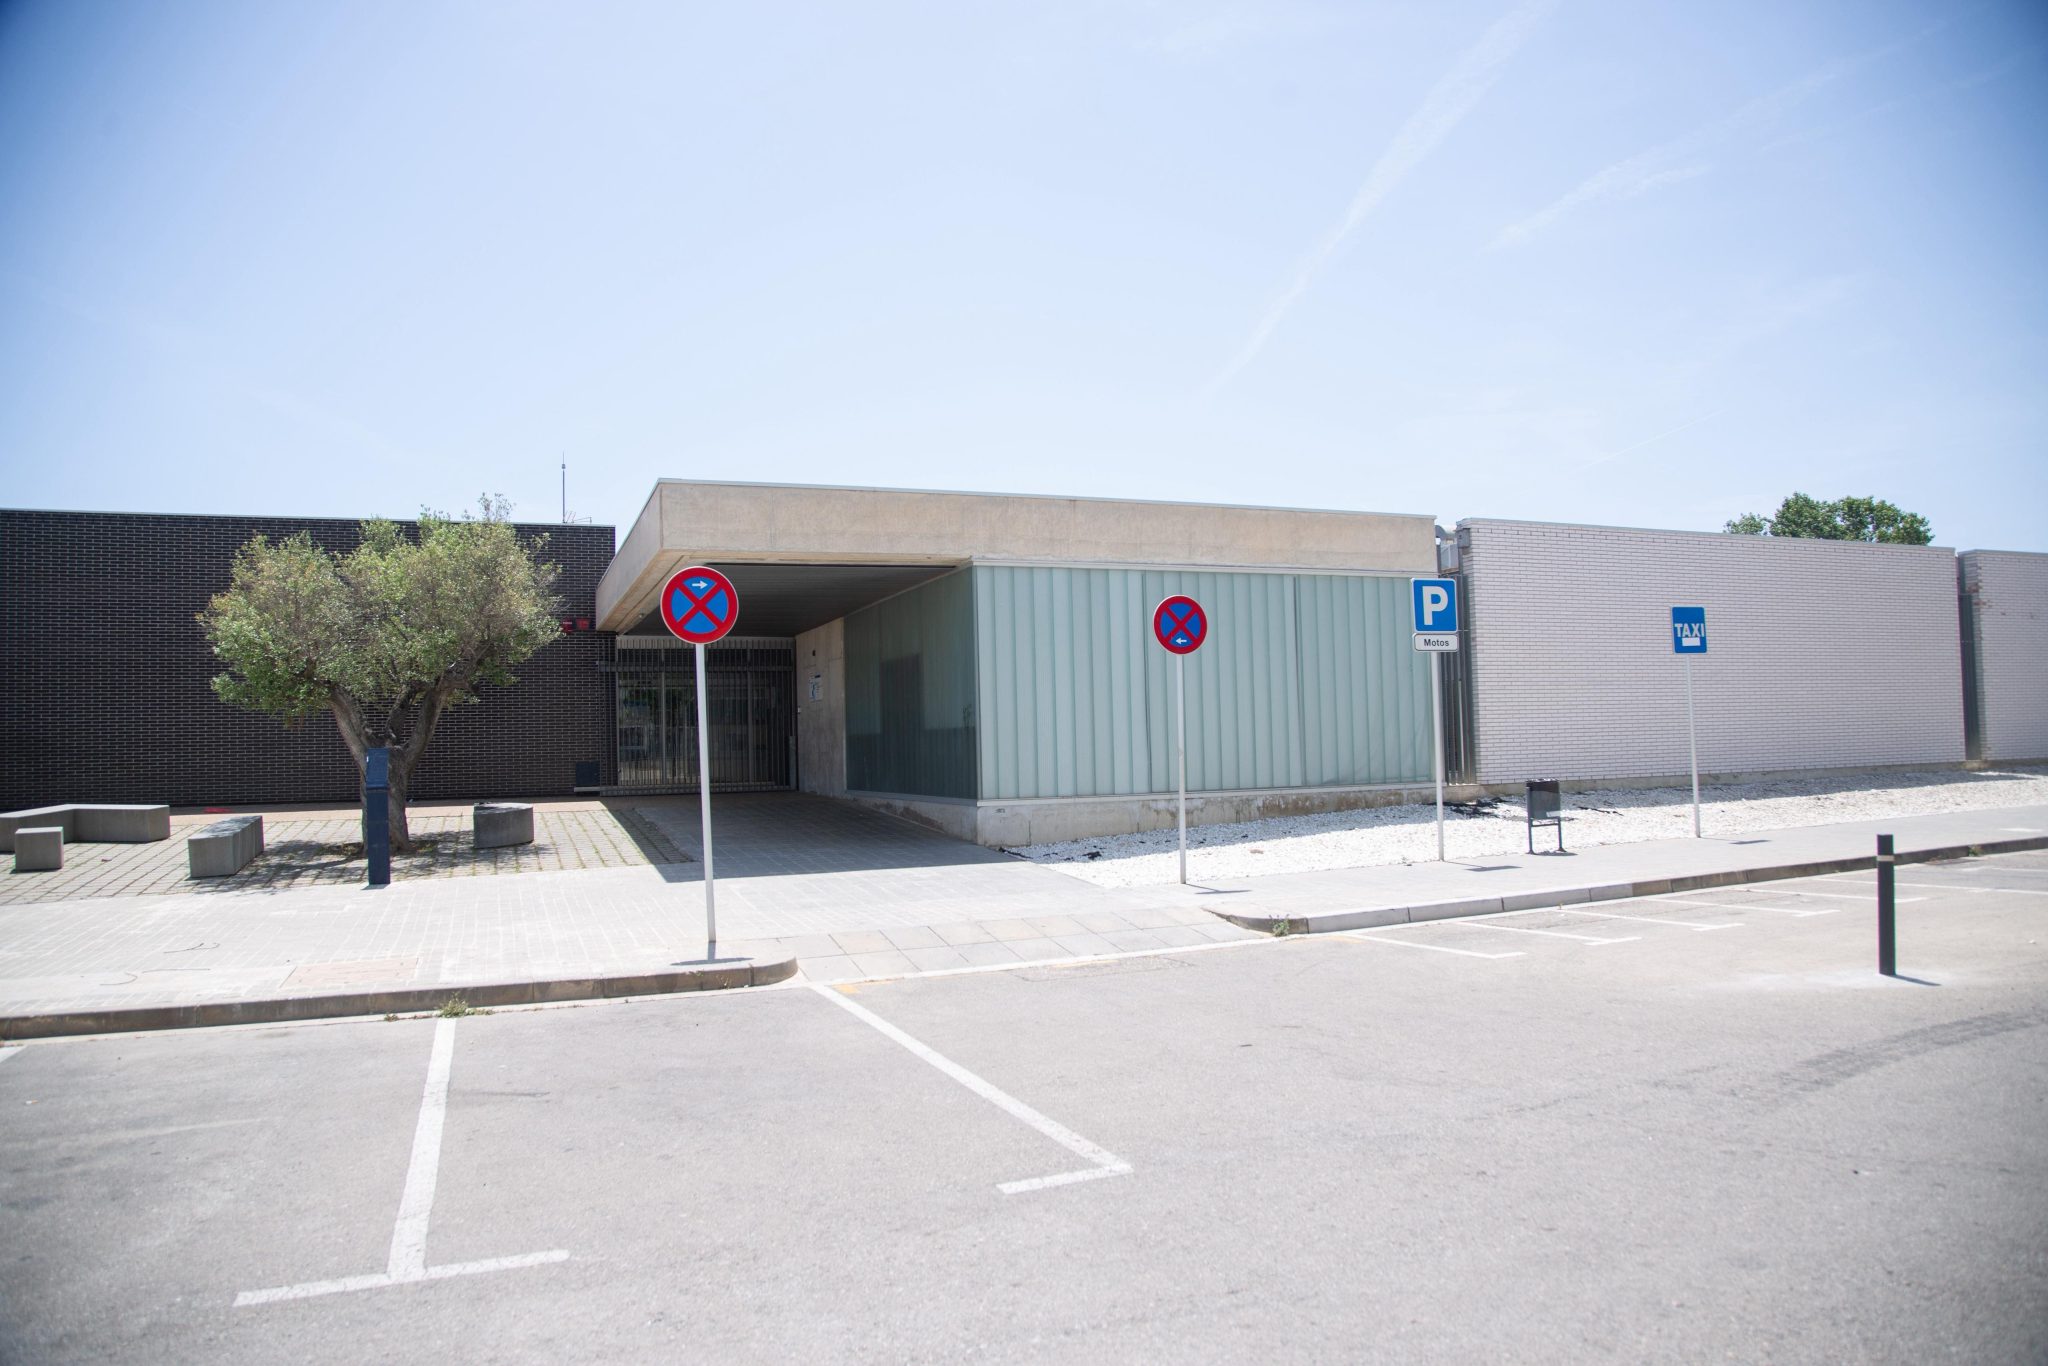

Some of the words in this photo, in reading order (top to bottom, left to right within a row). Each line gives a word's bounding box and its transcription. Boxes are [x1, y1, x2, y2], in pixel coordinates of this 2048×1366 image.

[1422, 586, 1448, 625] P
[1674, 623, 1705, 637] TAXI
[1423, 638, 1450, 647] Motos
